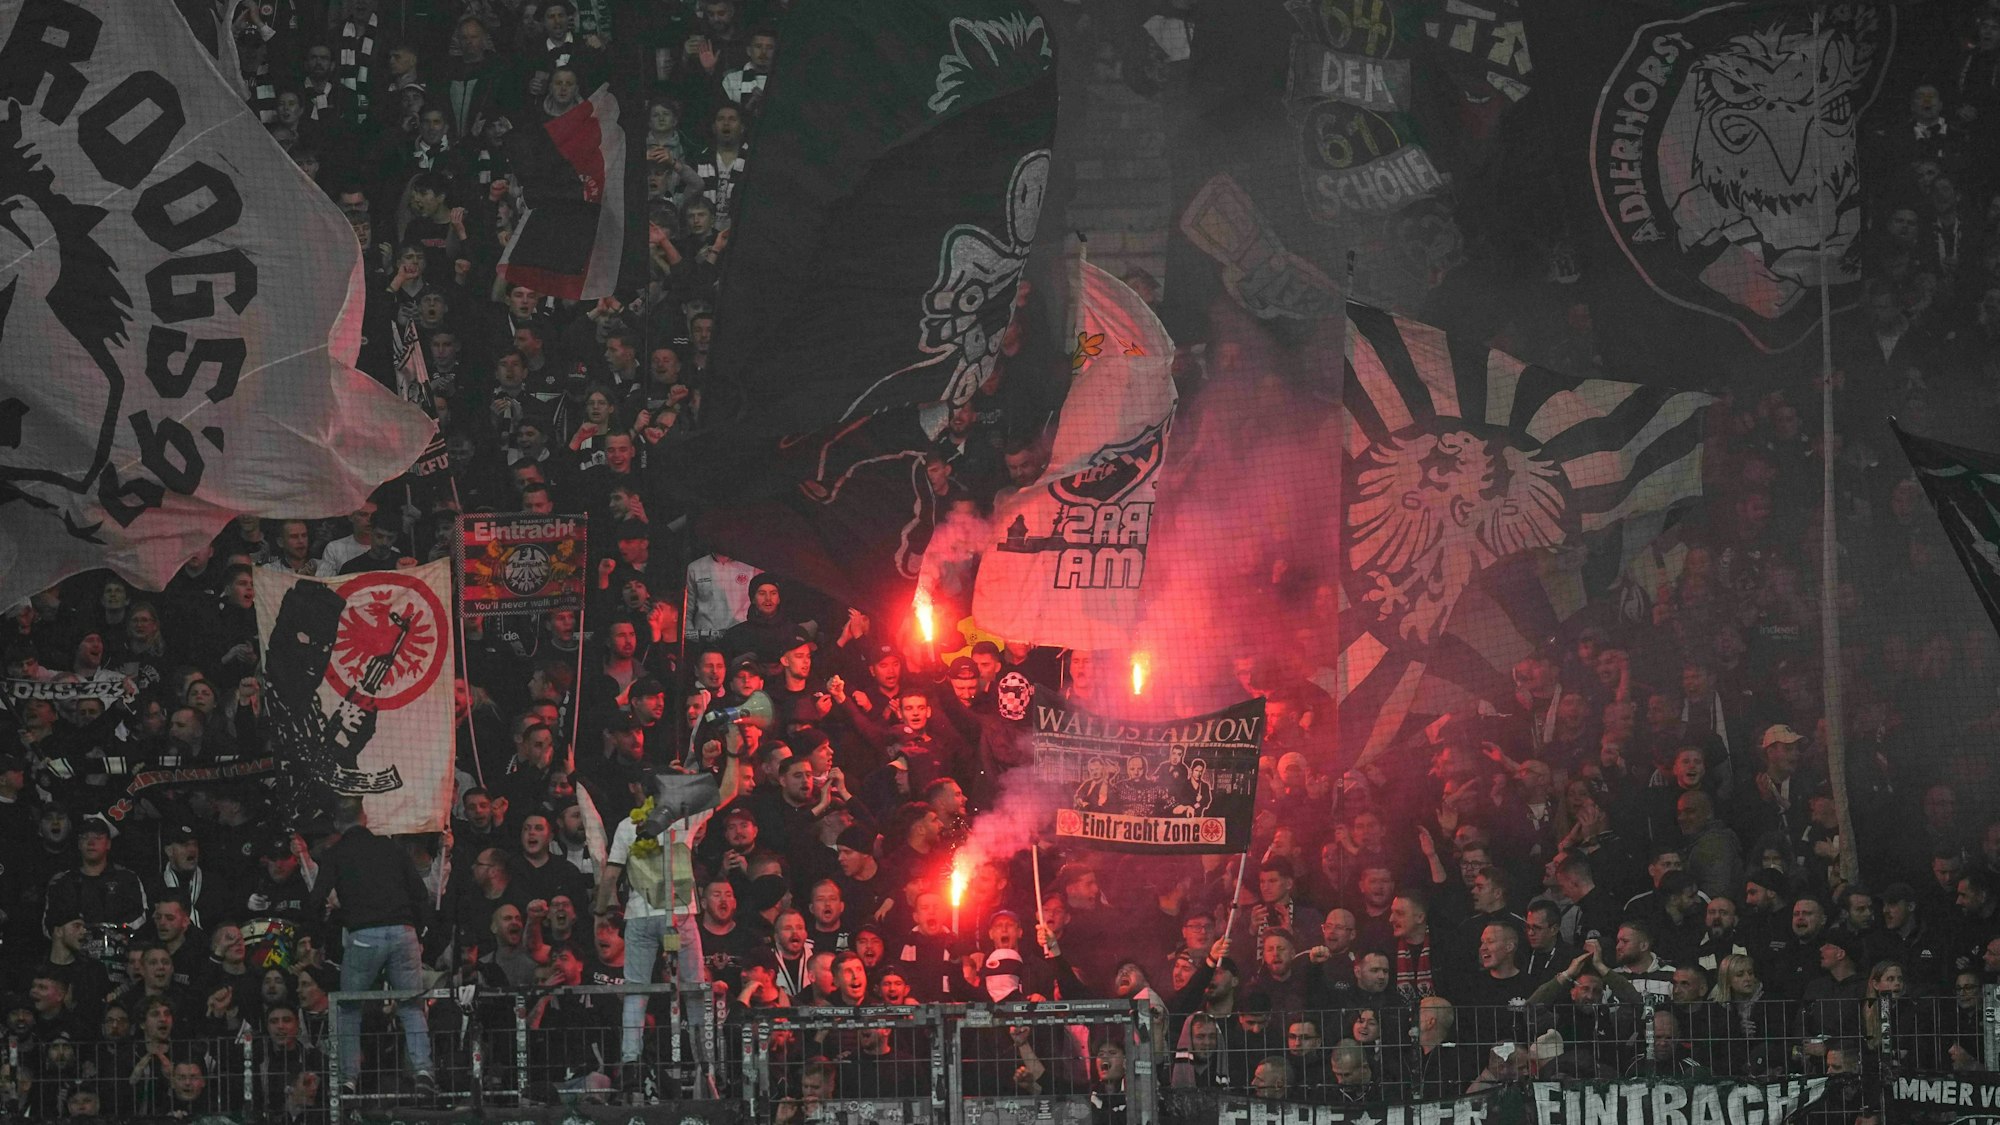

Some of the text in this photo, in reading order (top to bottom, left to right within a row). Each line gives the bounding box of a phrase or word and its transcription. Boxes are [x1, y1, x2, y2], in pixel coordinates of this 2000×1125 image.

[1321, 52, 1395, 104] DEM
[474, 518, 577, 541] Eintracht
[475, 602, 499, 610] You'll
[502, 600, 527, 609] never
[531, 598, 551, 606] walk
[1037, 705, 1260, 744] WALDSTADION
[1082, 814, 1200, 842] Eintracht Zone
[1532, 1076, 1828, 1125] EINTRACHT
[1893, 1077, 1974, 1107] IMMER
